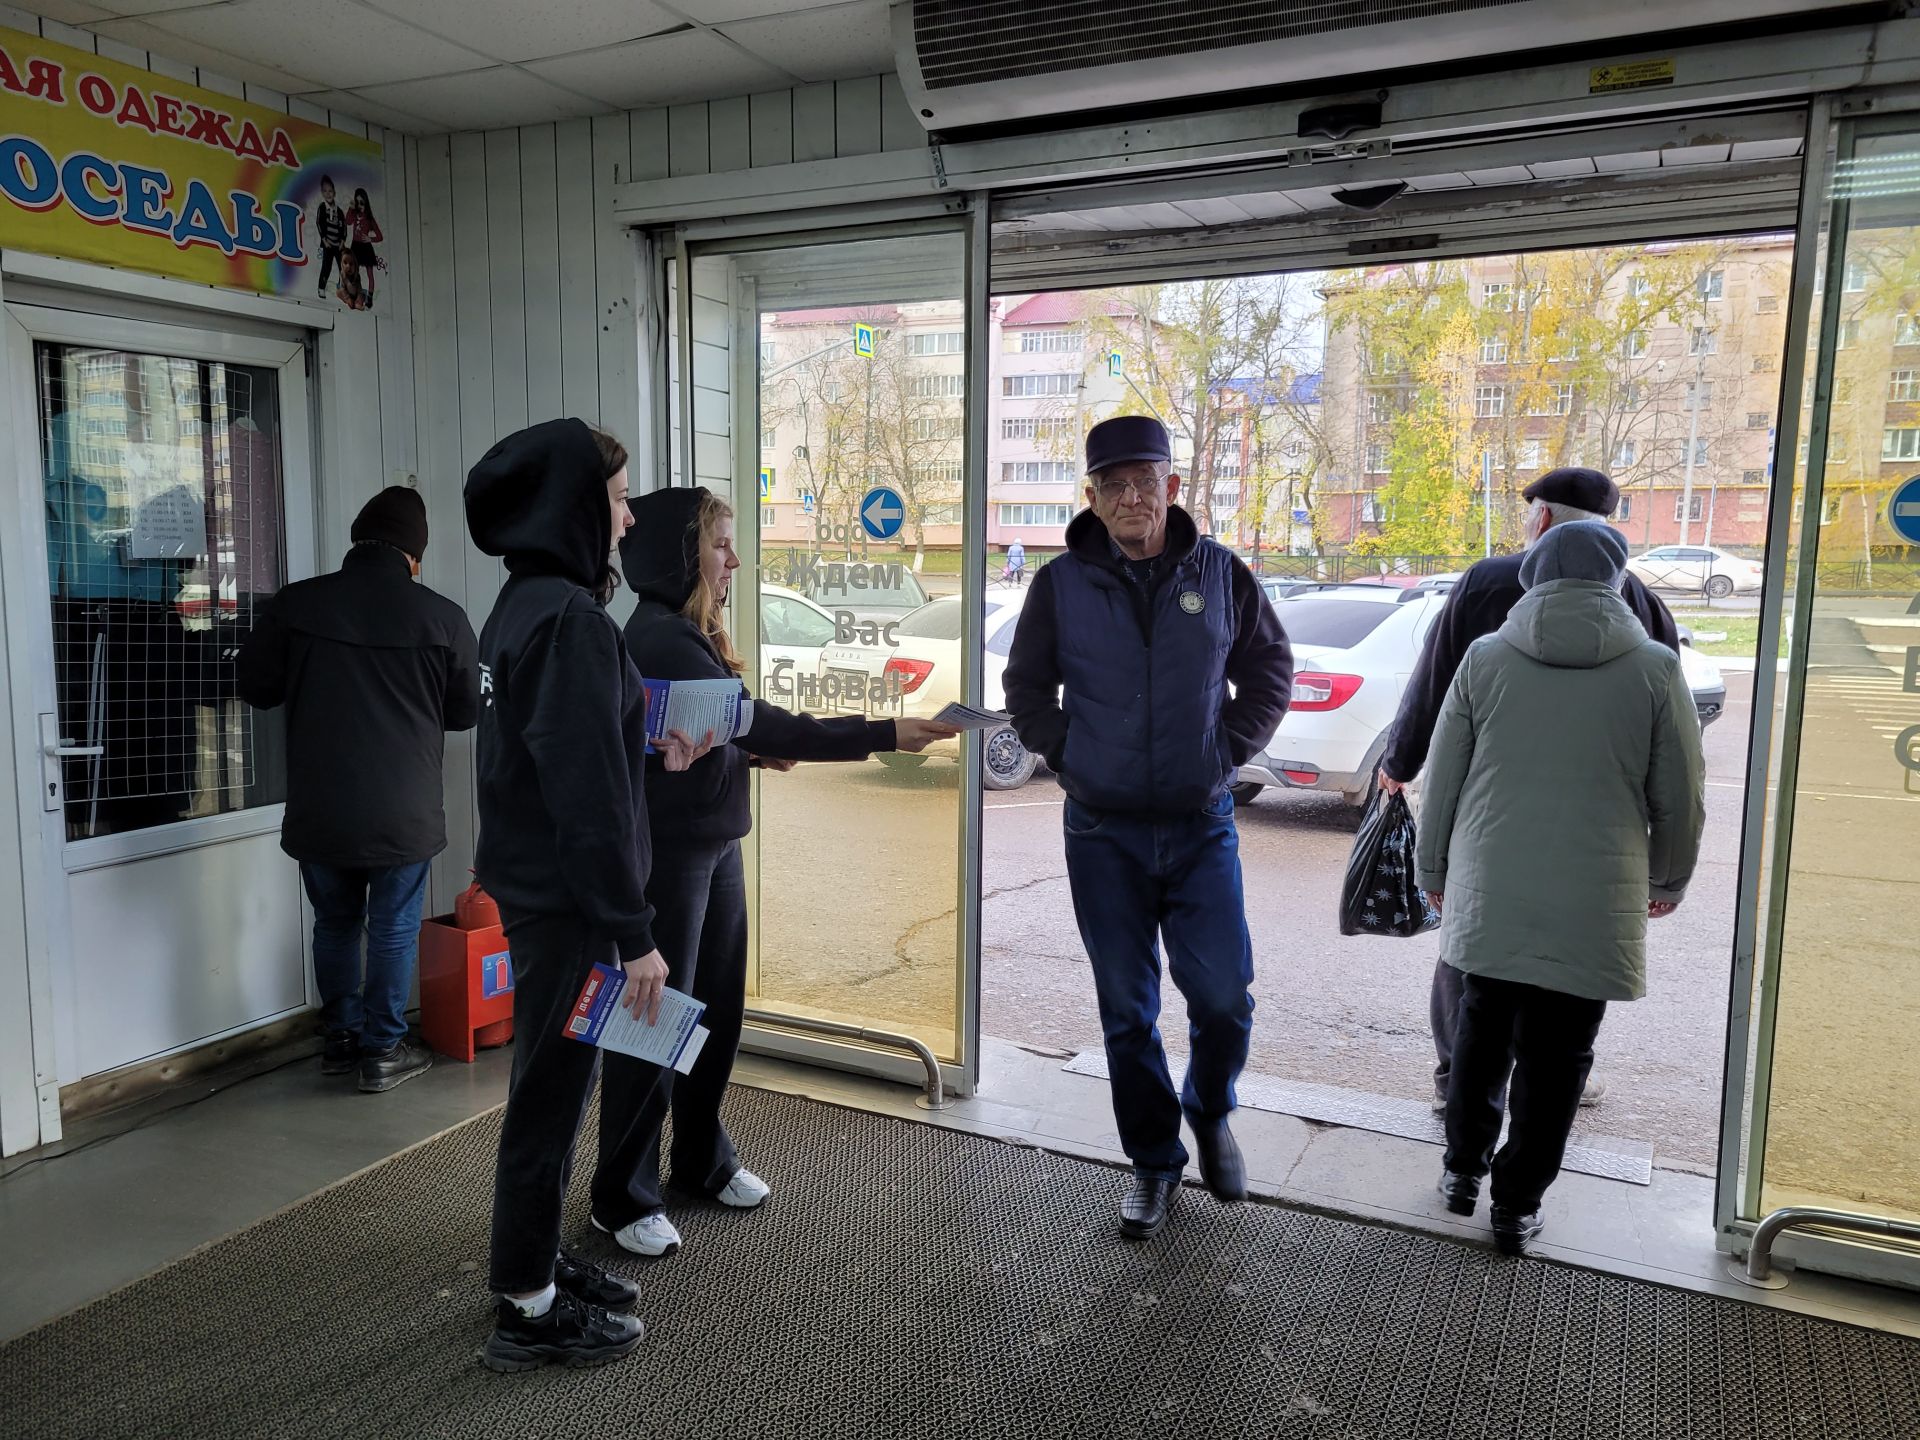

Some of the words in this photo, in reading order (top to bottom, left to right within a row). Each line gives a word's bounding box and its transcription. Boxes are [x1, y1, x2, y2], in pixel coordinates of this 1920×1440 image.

[79, 75, 301, 168] ОДЕЖДА
[0, 137, 306, 263] ОСЕДЫ
[834, 610, 900, 647] Вас
[772, 661, 901, 704] Снова!
